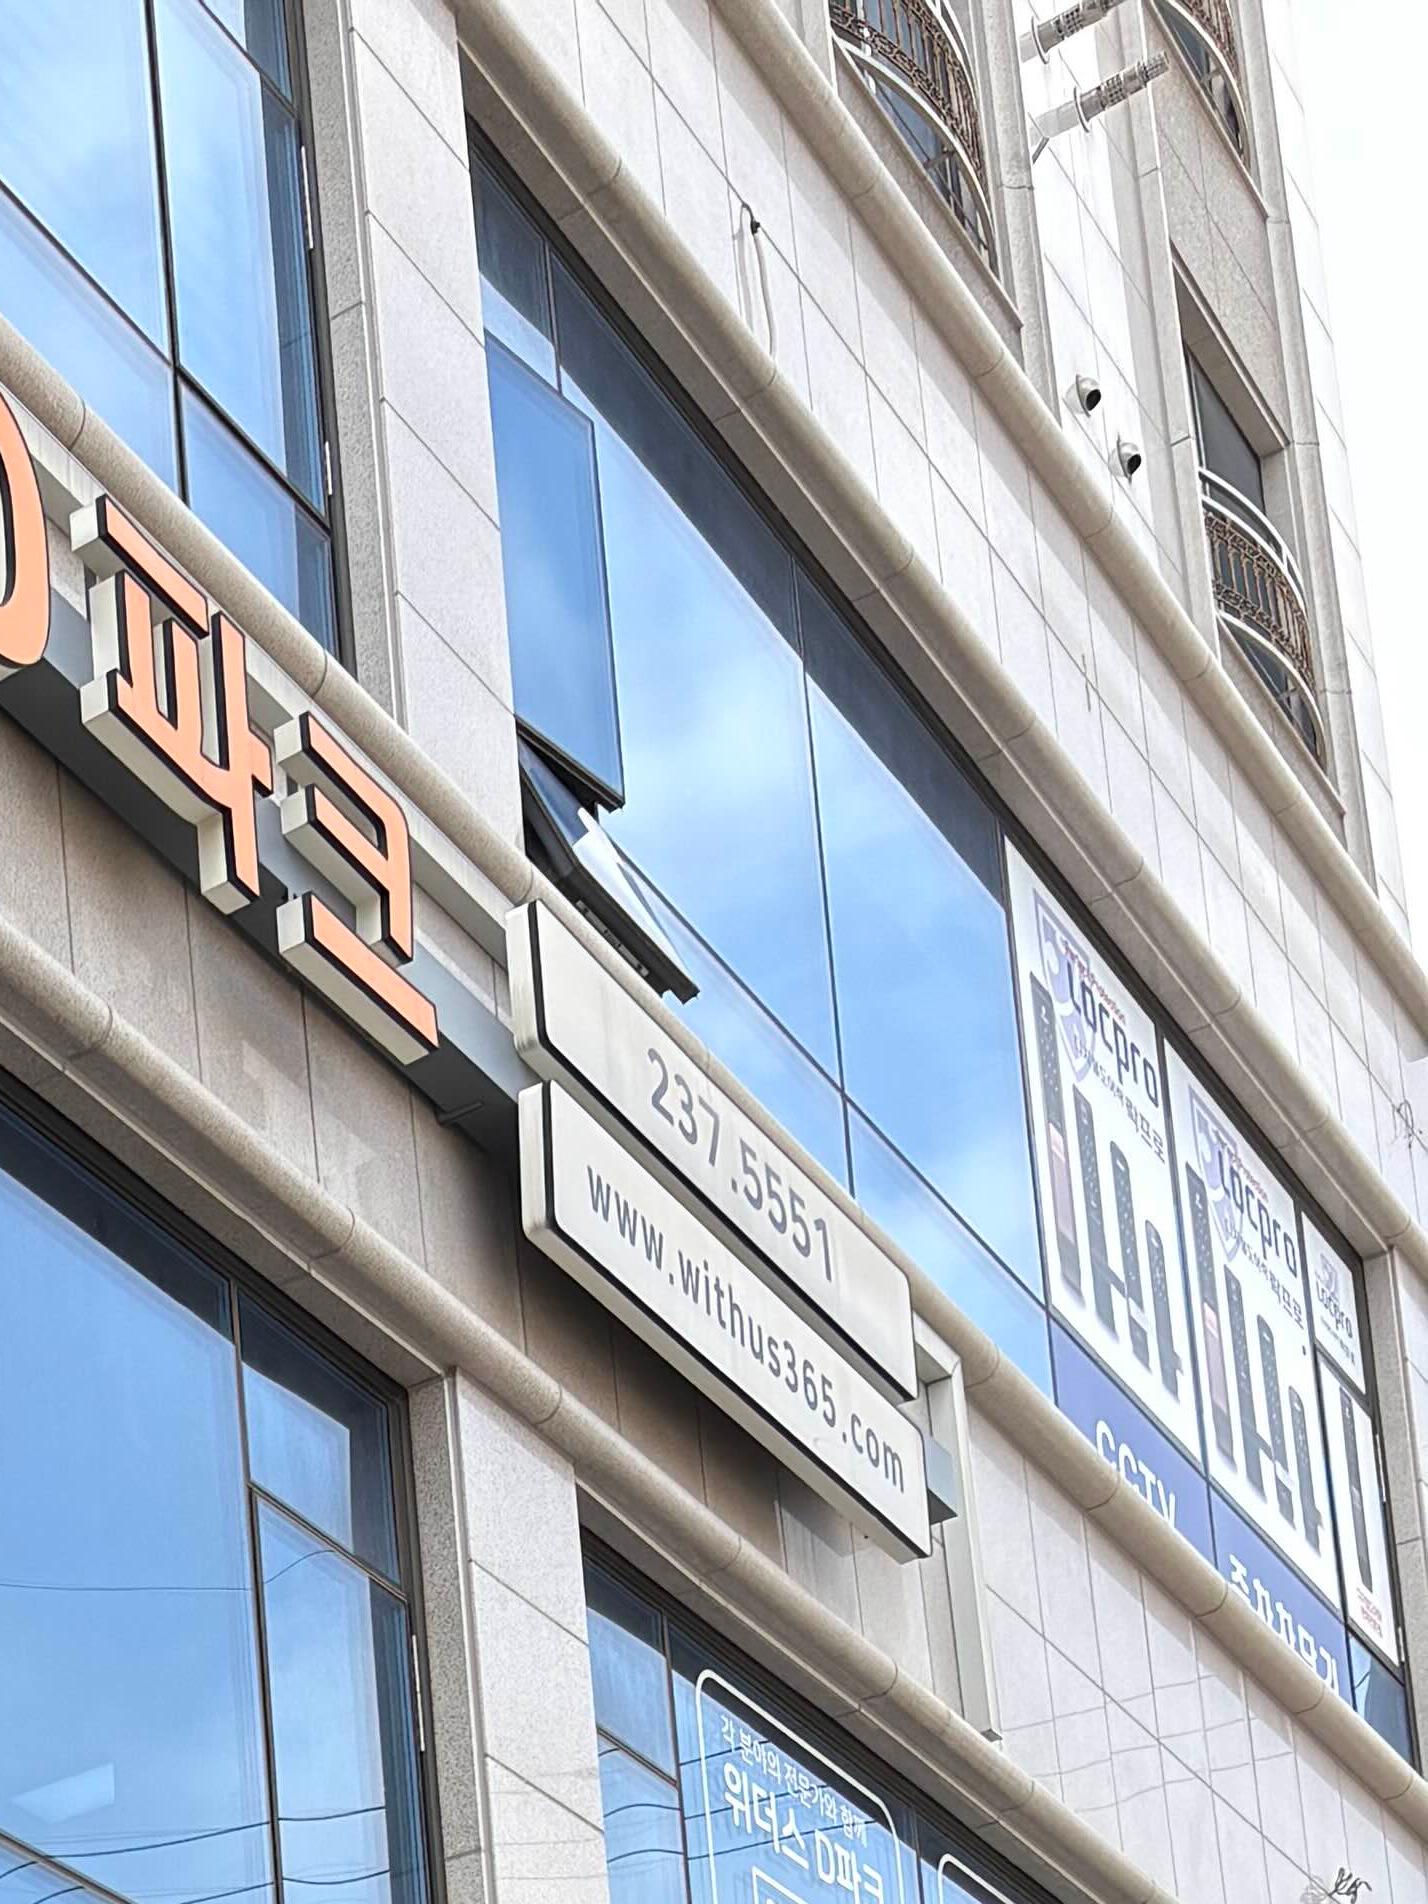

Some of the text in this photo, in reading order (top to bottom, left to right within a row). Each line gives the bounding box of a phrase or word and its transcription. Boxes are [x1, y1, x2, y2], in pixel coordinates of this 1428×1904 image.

[644, 1045, 838, 1284] 237.5551
[584, 1163, 908, 1497] www.withus365.com
[1095, 1420, 1177, 1528] CCTV
[723, 1762, 810, 1870] 위더스
